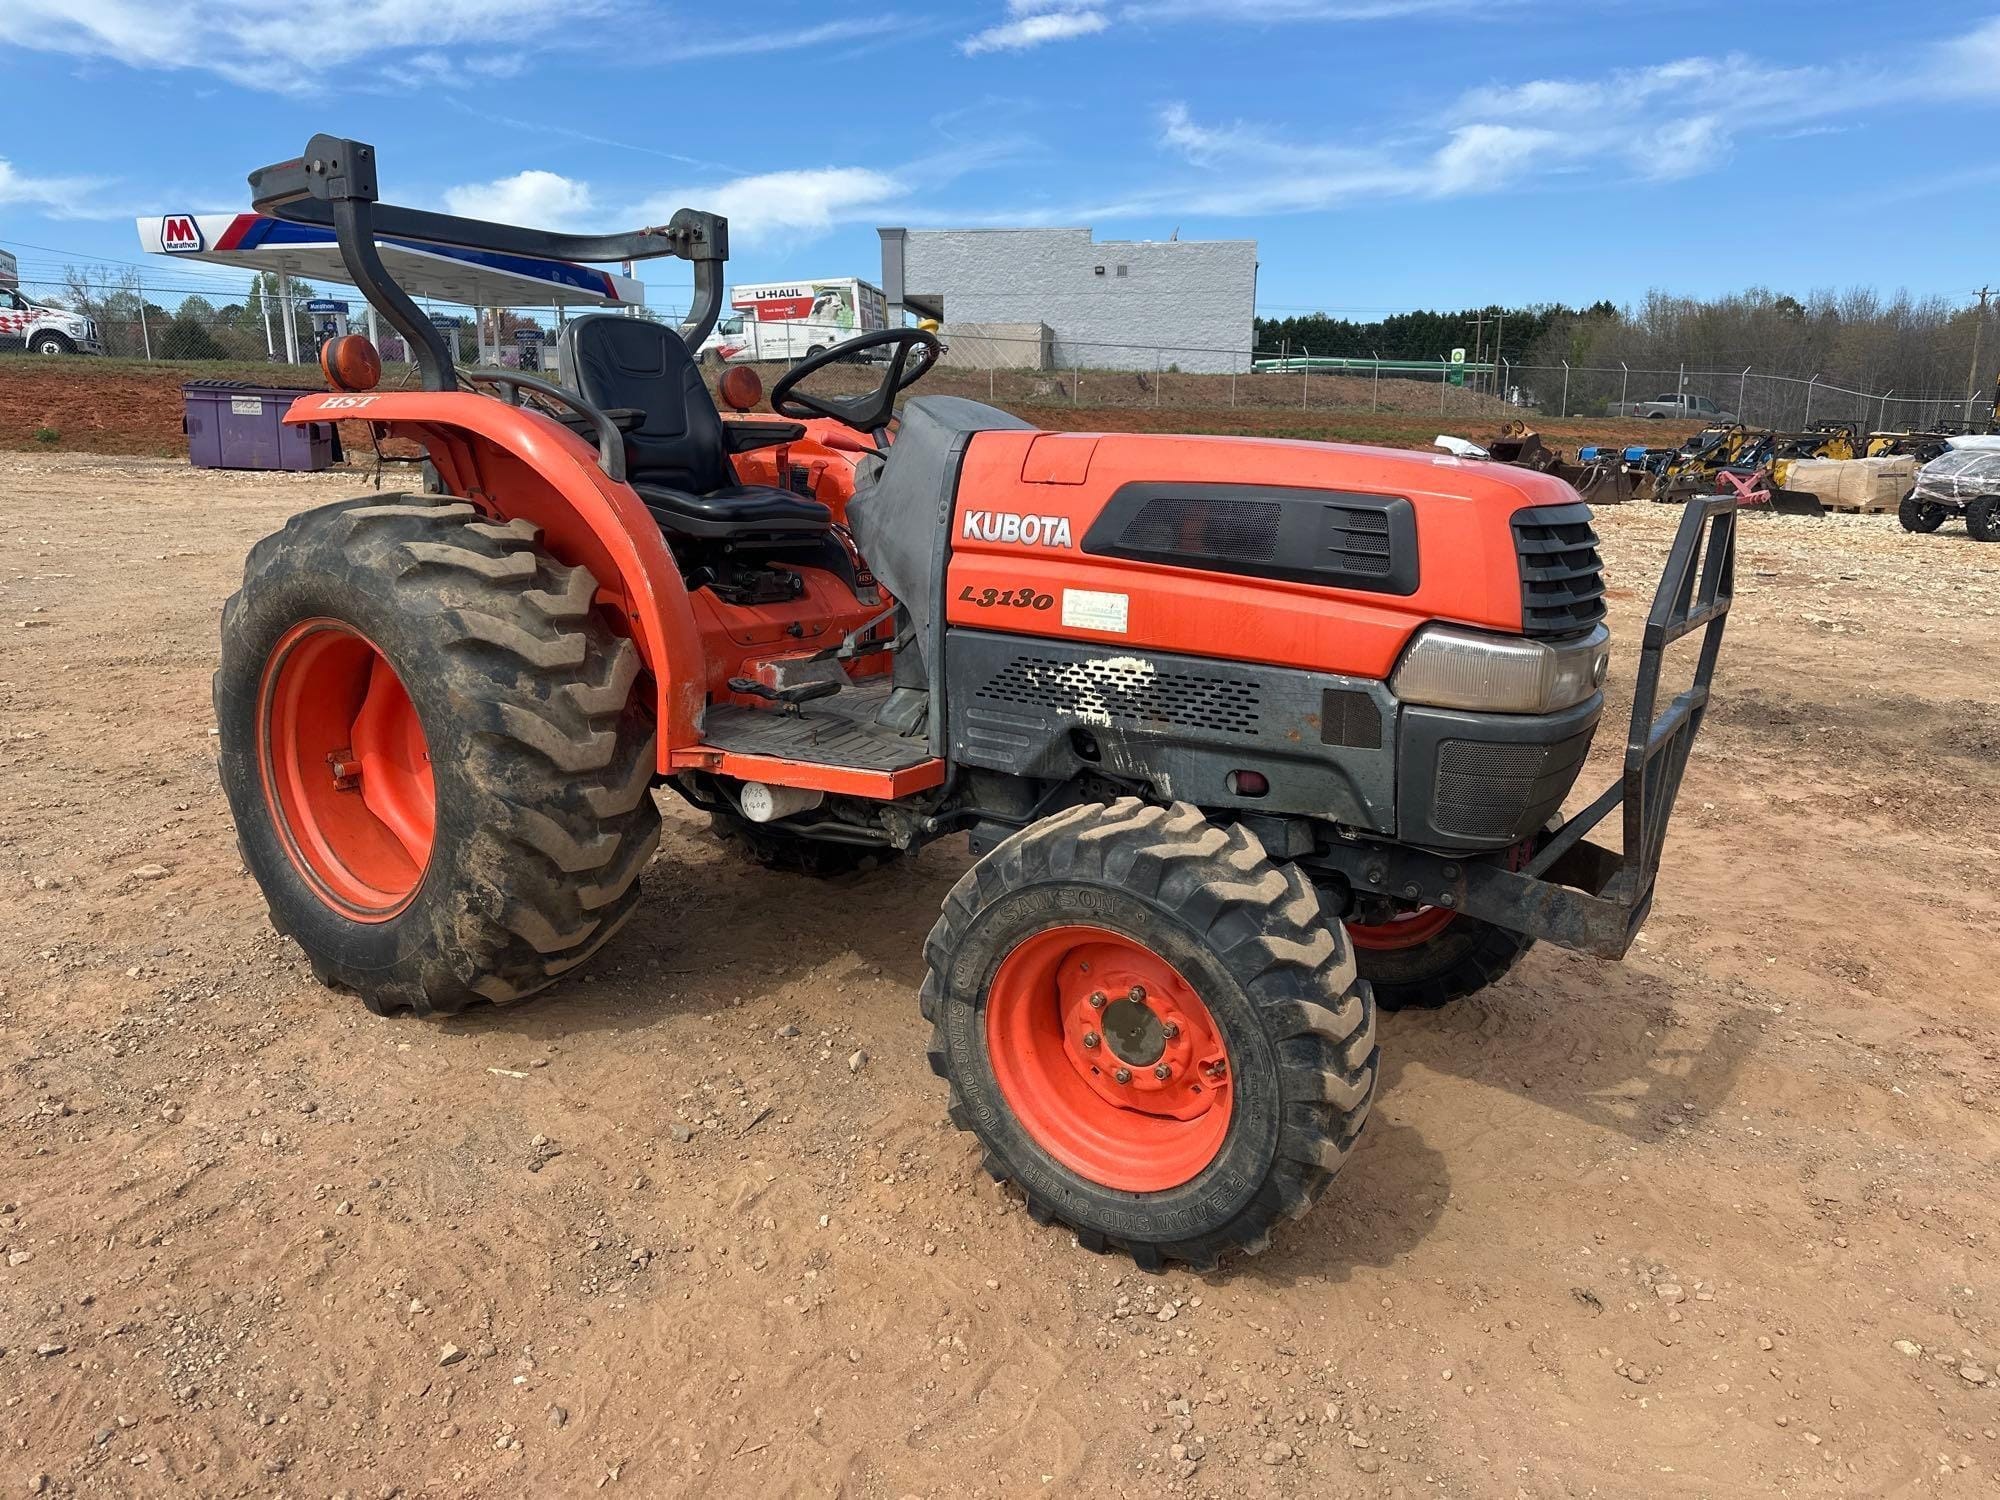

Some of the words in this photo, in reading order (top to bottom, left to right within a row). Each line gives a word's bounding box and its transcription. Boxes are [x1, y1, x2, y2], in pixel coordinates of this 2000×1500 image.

[167, 219, 195, 241] M
[755, 288, 802, 299] U-HAUL
[317, 396, 381, 409] HST
[963, 510, 1073, 548] KUBOTA
[958, 586, 1054, 610] L3130
[1000, 889, 1119, 924] SAMSON
[1024, 1161, 1091, 1217] STEER
[1157, 1169, 1248, 1232] PREMIUM
[1101, 1208, 1151, 1232] SKID
